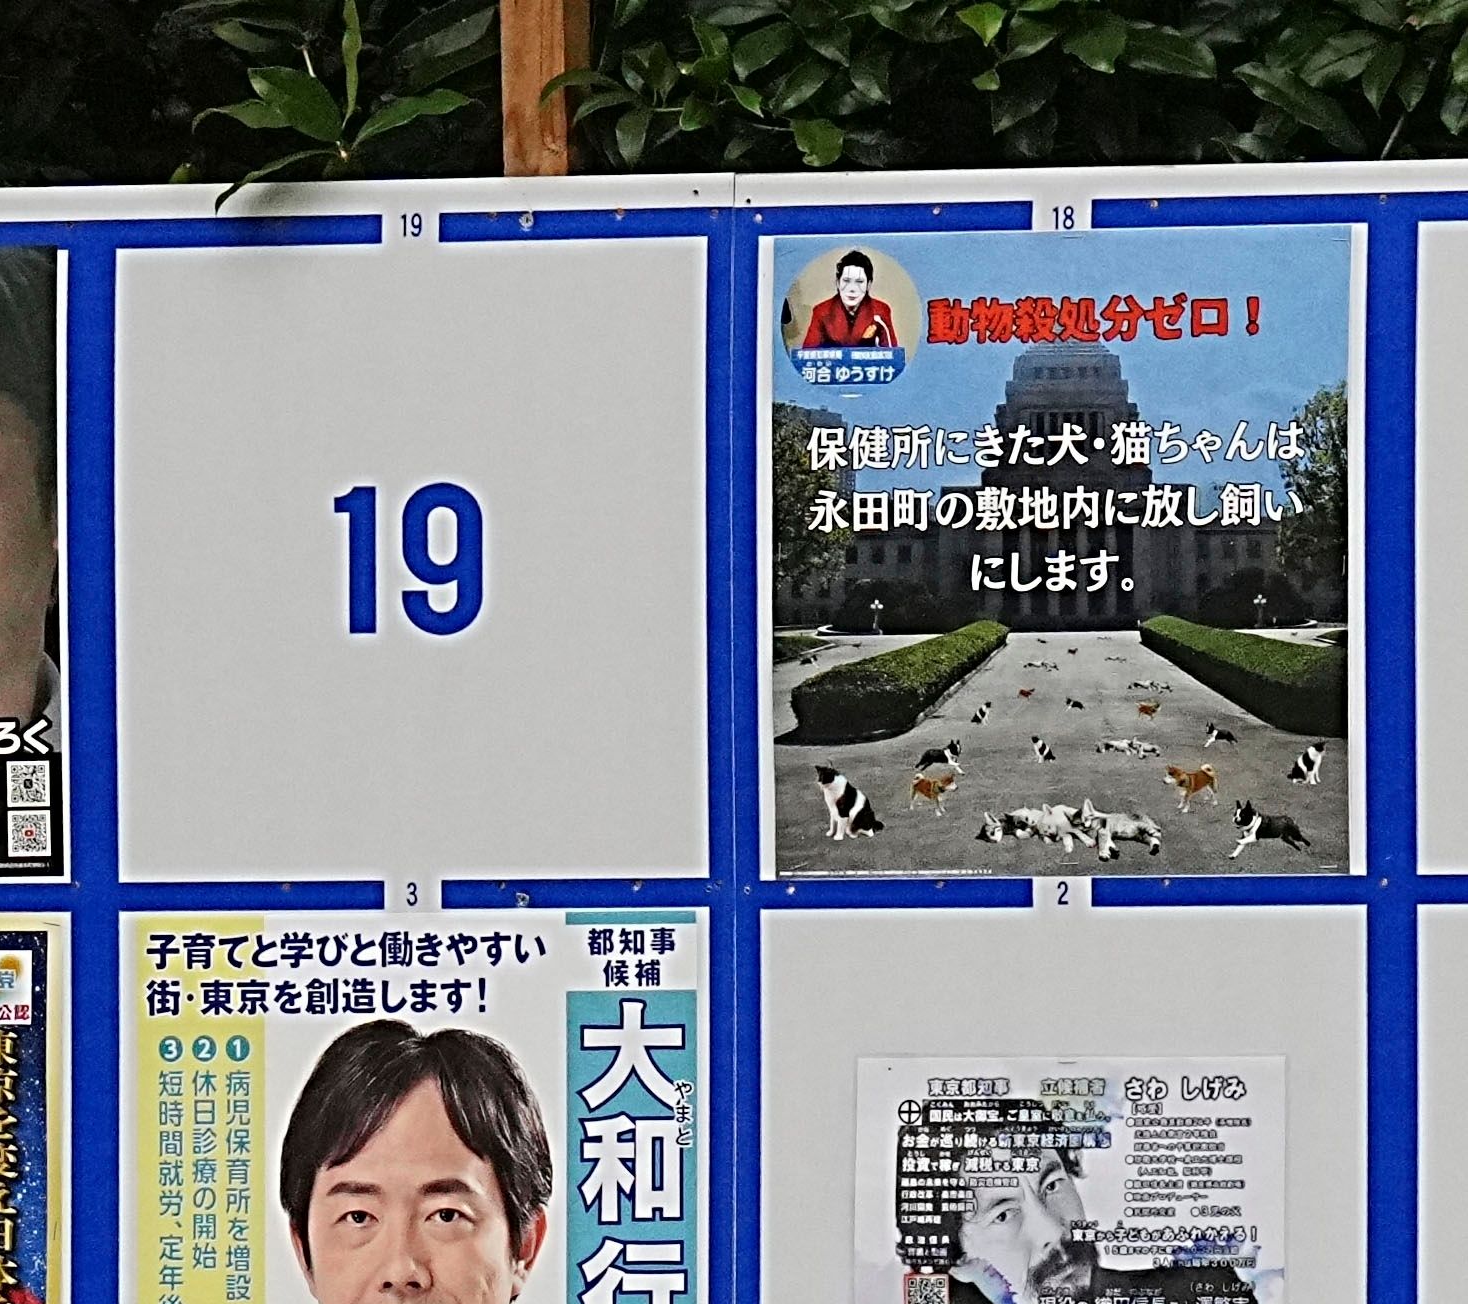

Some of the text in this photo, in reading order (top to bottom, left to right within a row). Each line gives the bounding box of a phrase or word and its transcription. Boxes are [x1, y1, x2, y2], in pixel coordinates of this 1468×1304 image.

[1052, 207, 1074, 229] 18
[802, 366, 895, 383] 河合 ゆうすけ
[806, 421, 1305, 470] 保健所にきた犬・猫ちゃんは
[807, 482, 1303, 532] 永田町の敷地内に放し飼い
[335, 484, 482, 634] 19
[971, 551, 1134, 591] にします。
[1057, 882, 1068, 905] 2
[146, 932, 546, 970] 子育てと学びと働きやすい
[588, 929, 676, 955] 都知事
[603, 960, 662, 986] 候補
[146, 979, 488, 1018] 街・東京を創造します！
[928, 1078, 1104, 1096] 東京都知事 立候補者
[1125, 1077, 1247, 1099] さわ しげみ
[581, 1000, 685, 1225] 大和
[673, 1081, 693, 1146] やまと
[191, 1071, 217, 1269] 休日診療の開始
[226, 1071, 251, 1300] 病児保育所を増設
